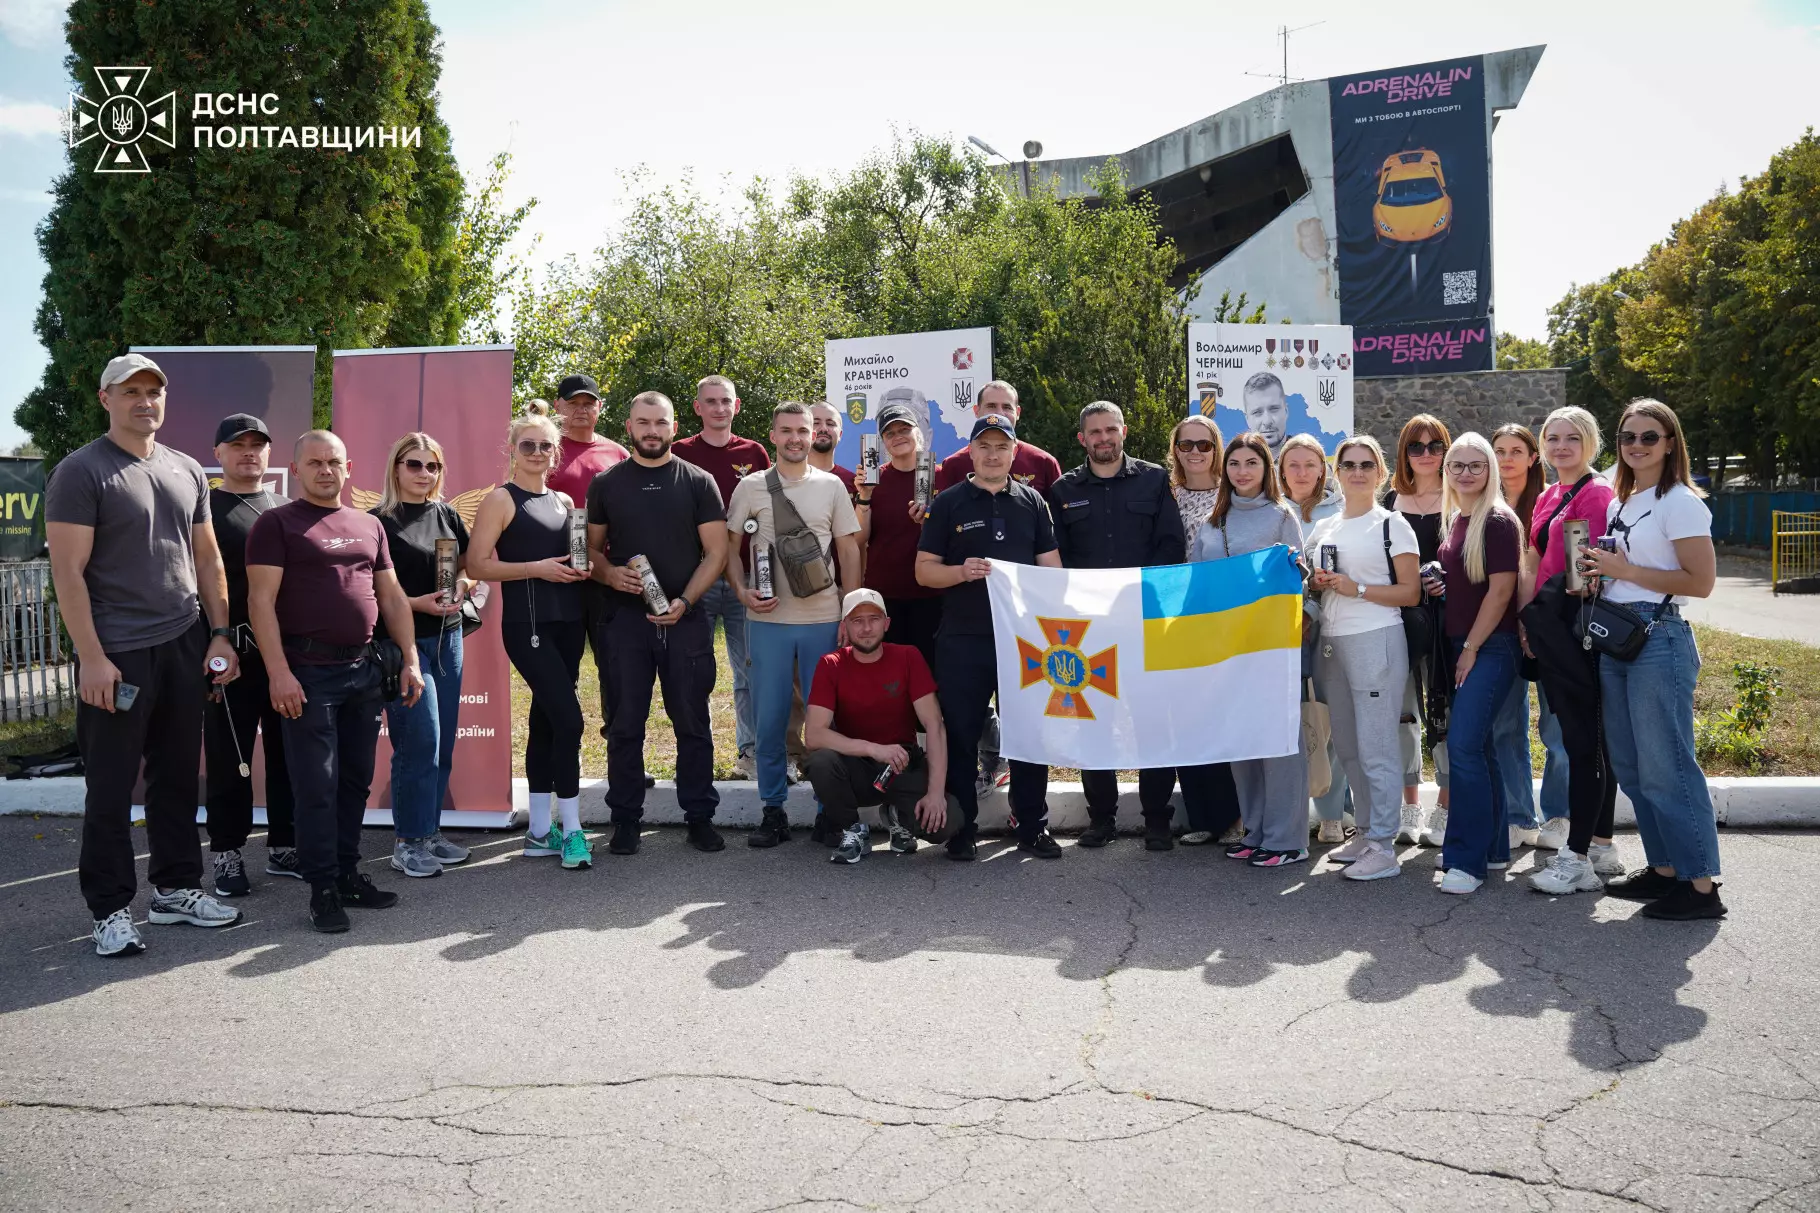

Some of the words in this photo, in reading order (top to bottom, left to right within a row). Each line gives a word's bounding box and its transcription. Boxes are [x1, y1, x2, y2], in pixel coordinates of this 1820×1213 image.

[1341, 66, 1473, 97] ADRENALIN
[1386, 82, 1453, 104] DRIVE
[1354, 116, 1368, 125] МИ
[1375, 112, 1404, 122] ТОБОЮ
[1405, 110, 1411, 118] В
[1411, 104, 1462, 117] АВТОСПОРТІ
[1196, 341, 1263, 355] Володимир
[1391, 343, 1464, 364] DRIVE
[844, 353, 894, 367] Михайло
[1196, 357, 1243, 369] ЧЕРНИШ
[844, 367, 909, 381] КРАВЧЕНКО
[1206, 371, 1217, 379] рік
[844, 383, 853, 391] 46
[854, 383, 873, 391] років
[0, 492, 39, 519] rv
[5, 525, 32, 536] missing
[455, 724, 495, 739] раїни
